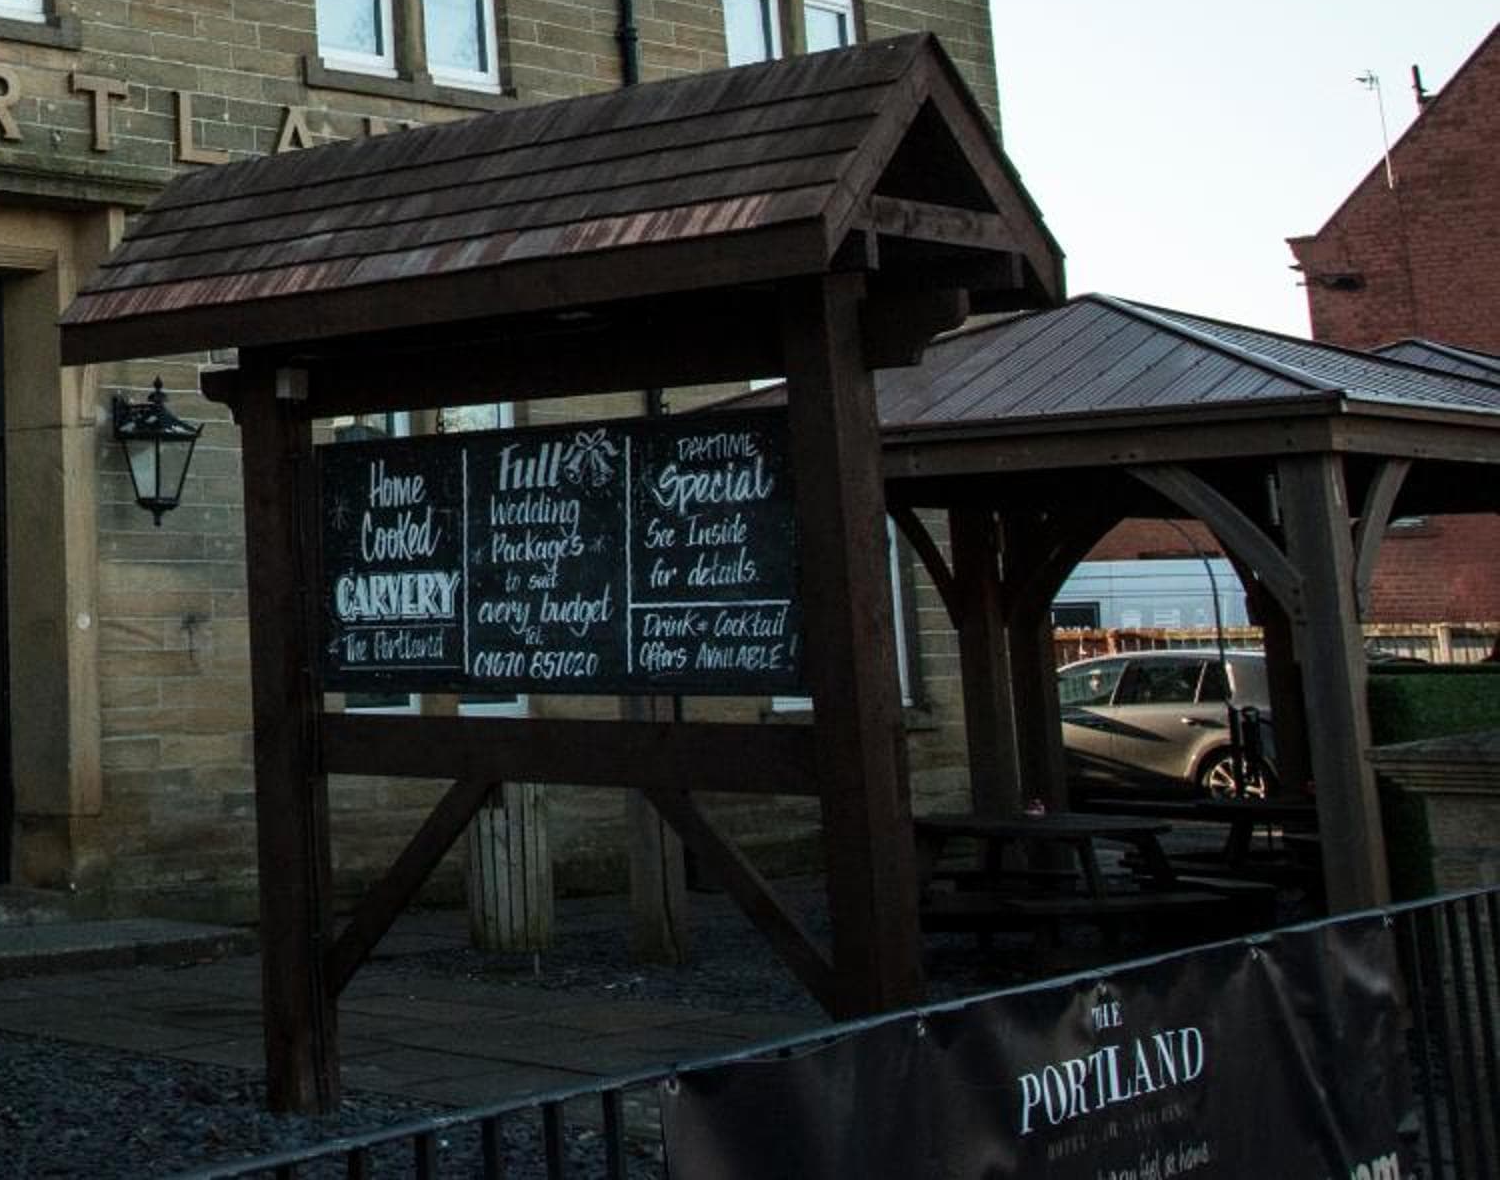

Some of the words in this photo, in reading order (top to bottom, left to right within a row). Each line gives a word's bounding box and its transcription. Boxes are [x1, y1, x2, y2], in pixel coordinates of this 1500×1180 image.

[499, 442, 563, 491] Full
[677, 432, 759, 462] DAYTIME
[369, 459, 427, 508] Home
[651, 455, 773, 515] Special
[361, 505, 442, 562] Cooked
[491, 493, 581, 539] Wedding
[644, 517, 677, 548] See
[685, 513, 748, 547] Inside
[491, 529, 585, 572] Packages
[505, 571, 521, 593] to
[528, 571, 559, 590] suit
[651, 557, 678, 588] for
[336, 571, 461, 622] CARVERY
[539, 582, 614, 638] budget
[642, 609, 701, 637] Drink
[713, 606, 789, 637] Cocktail
[342, 632, 367, 661] The
[374, 628, 445, 661] Portland
[474, 651, 526, 678] 01670
[639, 641, 688, 671] Offers
[1017, 1027, 1205, 1136] PORTLAND
